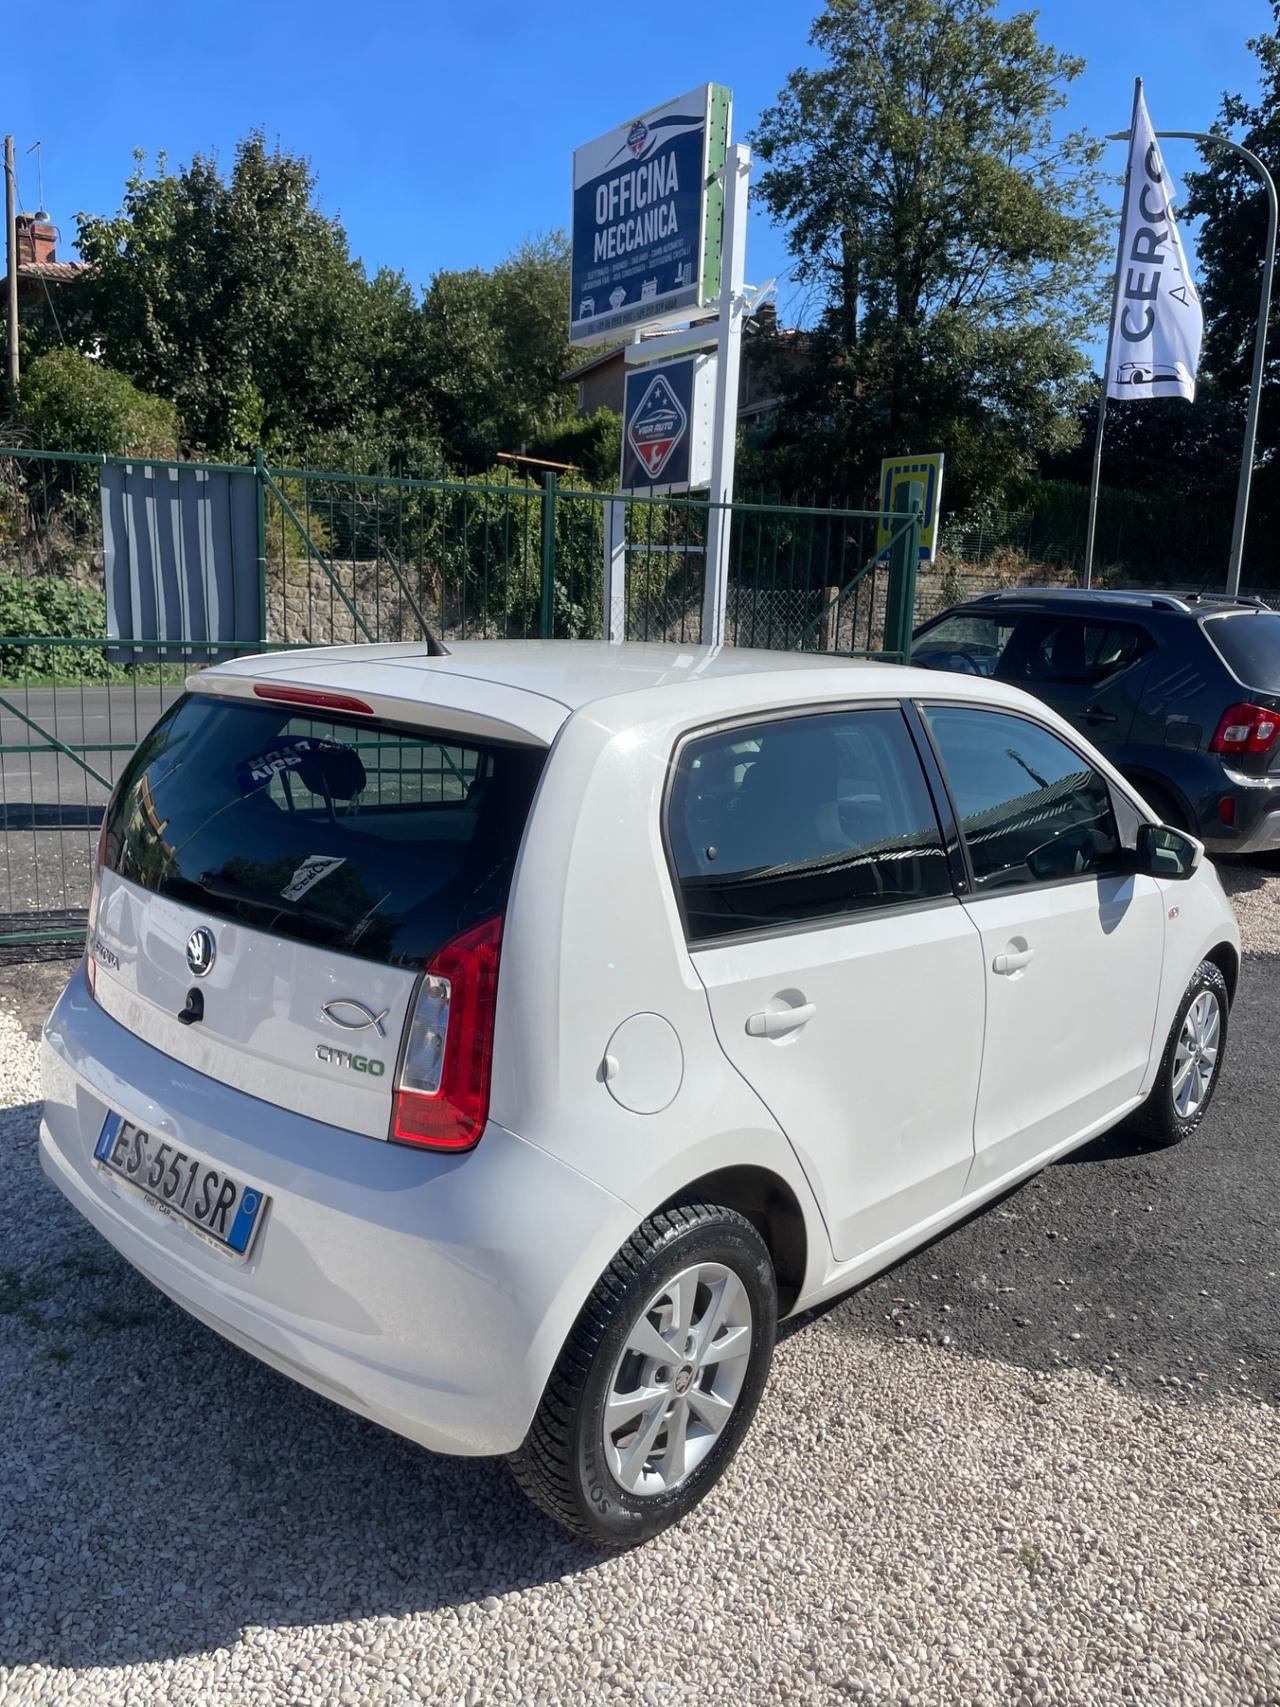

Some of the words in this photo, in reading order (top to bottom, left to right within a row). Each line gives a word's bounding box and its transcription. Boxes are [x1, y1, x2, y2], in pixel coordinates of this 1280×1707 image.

[595, 151, 679, 225] OFFICINA
[594, 200, 678, 263] MECCANICA
[653, 421, 674, 432] AUTO
[315, 1043, 385, 1077] CITIGO
[111, 1119, 149, 1174] ES
[148, 1142, 237, 1234] 551SR
[158, 1204, 172, 1217] CAR
